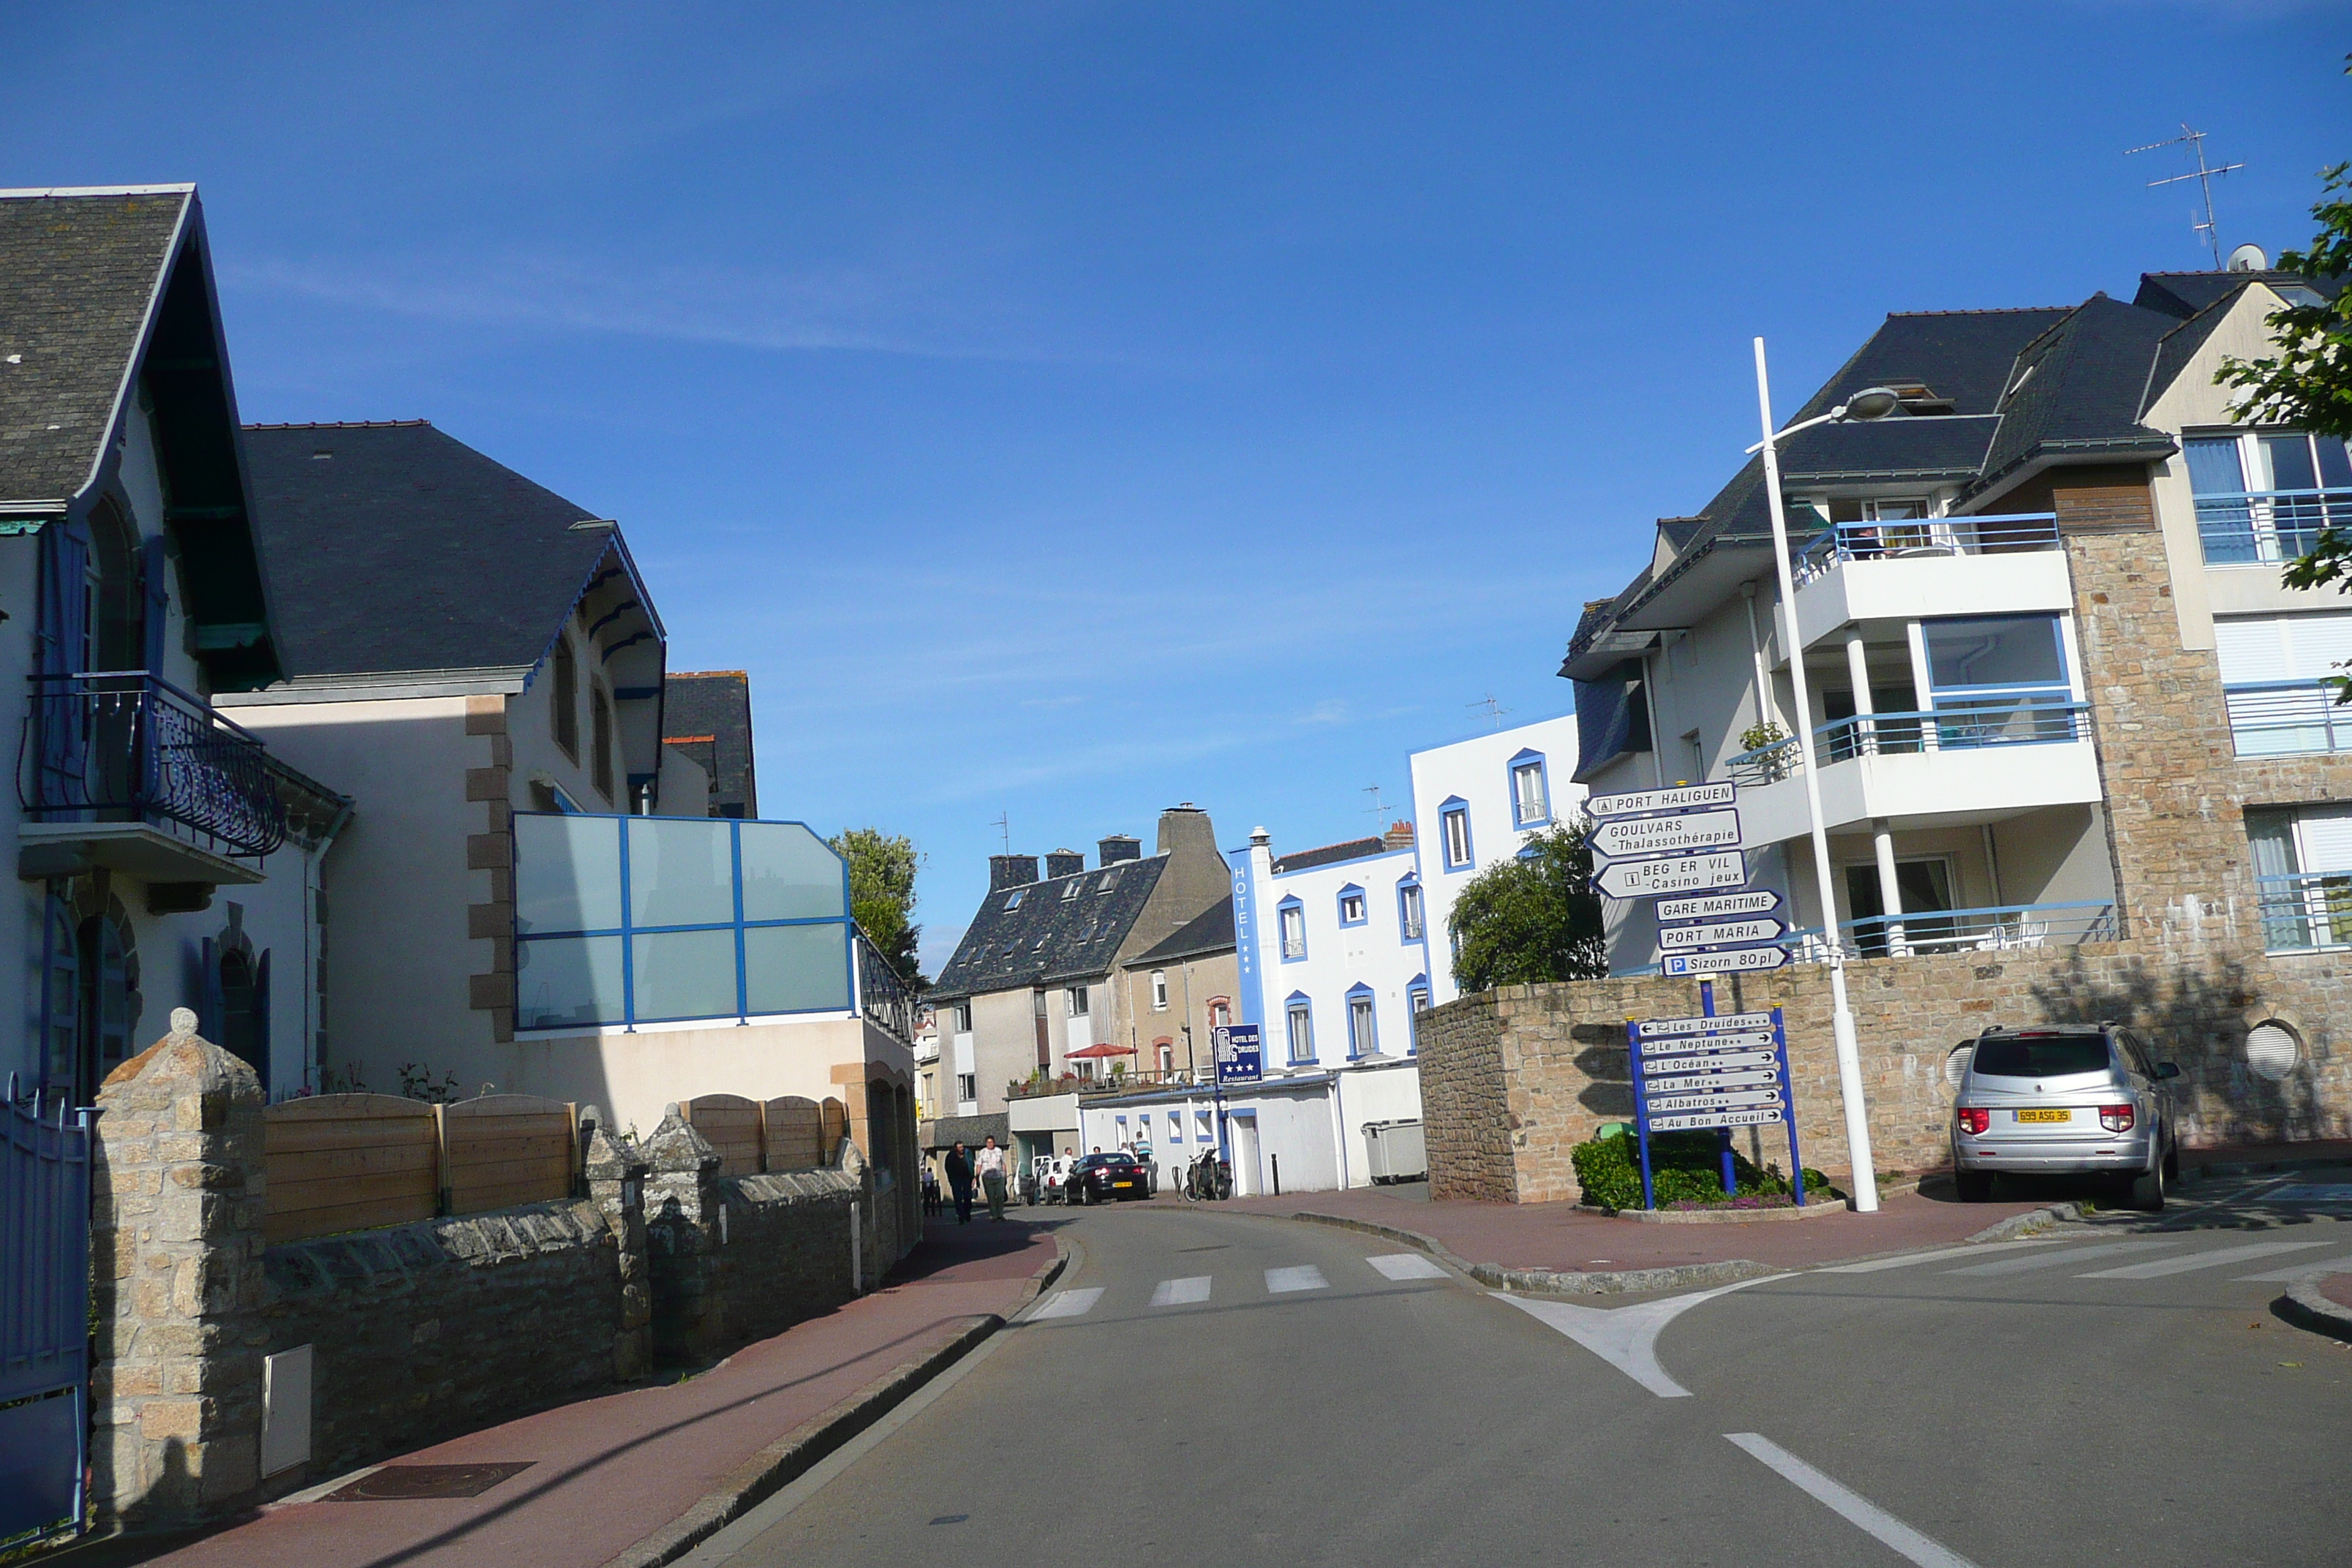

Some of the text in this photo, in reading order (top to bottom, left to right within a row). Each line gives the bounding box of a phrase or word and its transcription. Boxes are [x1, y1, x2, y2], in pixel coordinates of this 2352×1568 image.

[1617, 787, 1730, 810] PORT HALIGUEN
[1610, 821, 1682, 837] GOULVARS
[1643, 858, 1730, 876] BEG ER VIL
[1710, 872, 1740, 886] jeux
[1235, 867, 1248, 939] HOTEL
[1663, 896, 1768, 916] GARE MARITIME
[1667, 925, 1760, 943] PORT MARIA
[1690, 957, 1730, 970] Sizorn
[1739, 955, 1757, 965] 80
[1673, 1018, 1746, 1031] Les Druides
[1659, 1039, 1727, 1051] Le Neptune
[1664, 1079, 1705, 1090] La Mer
[1665, 1099, 1715, 1109] Albatros
[1668, 1112, 1765, 1128] Au Bon Accueil
[2020, 1111, 2068, 1120] 699 ASG 35
